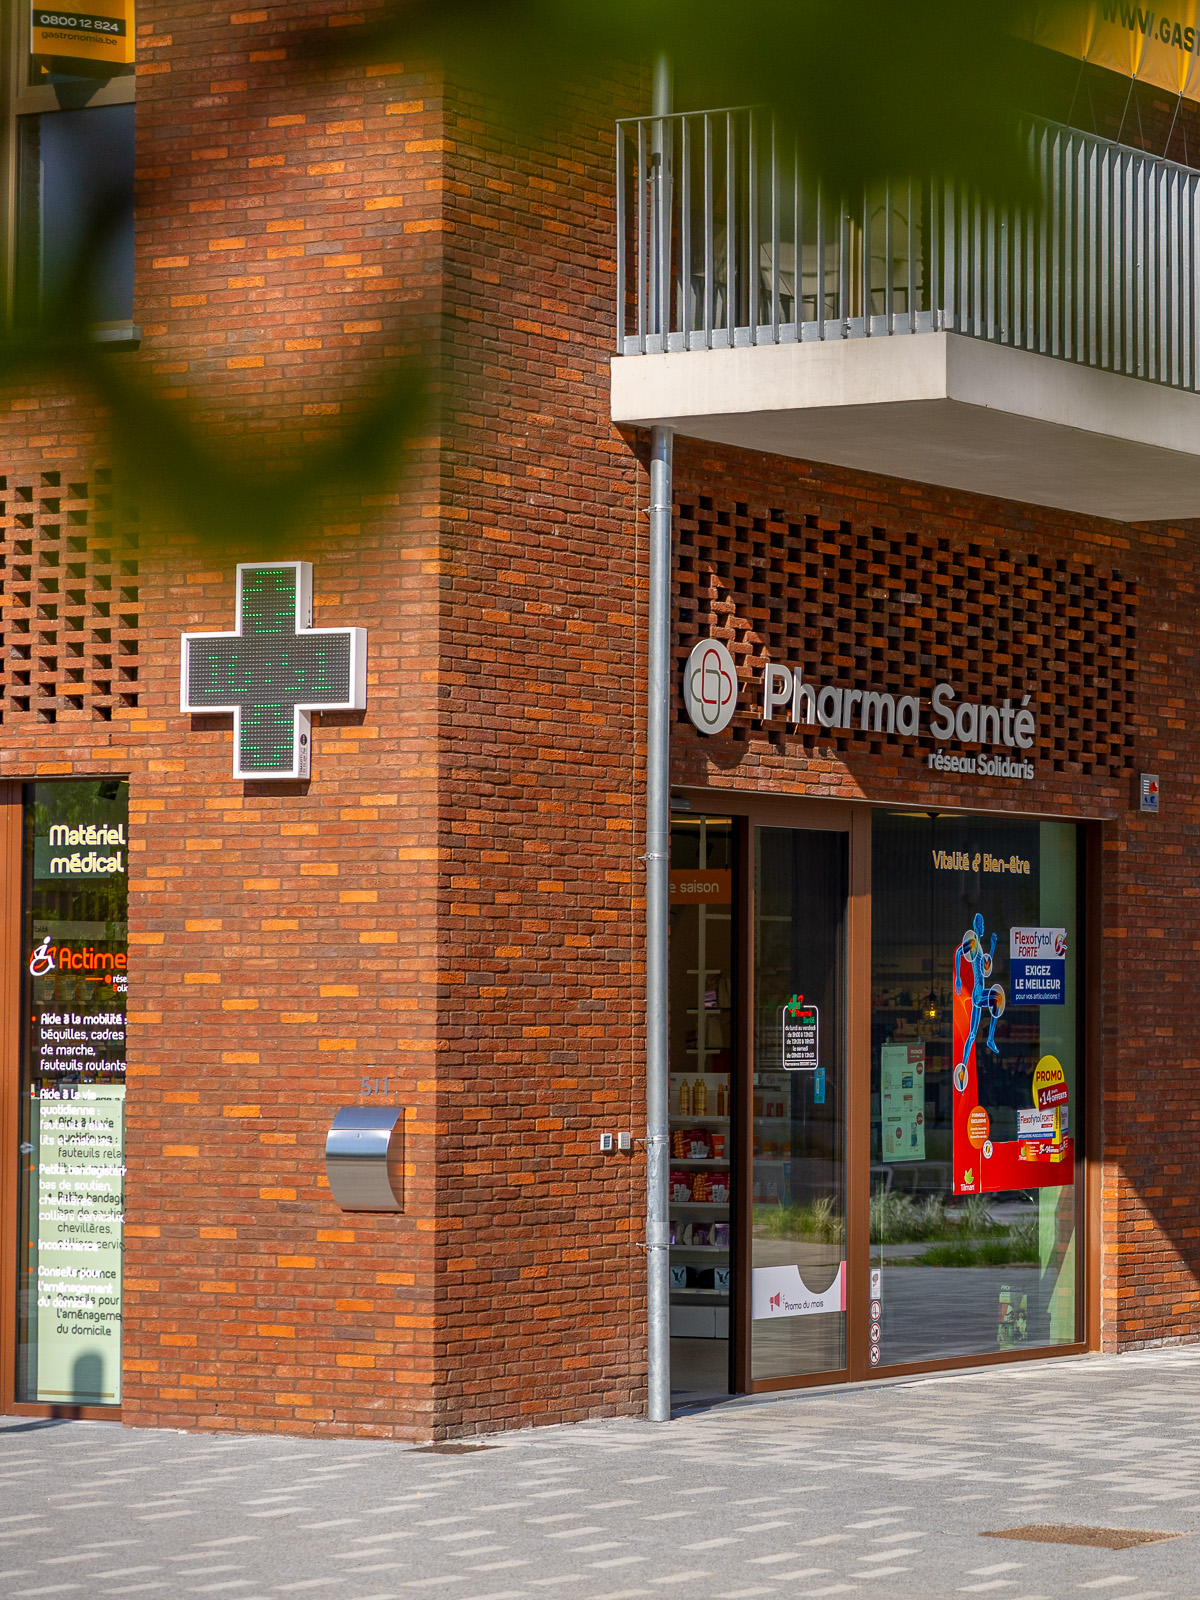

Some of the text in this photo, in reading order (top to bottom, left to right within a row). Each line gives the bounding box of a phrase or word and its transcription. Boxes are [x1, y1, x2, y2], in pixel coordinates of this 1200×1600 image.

[40, 15, 119, 32] 0800 12 824
[41, 31, 118, 45] gastronomia.be
[764, 662, 1036, 749] Pharma Santé
[928, 749, 1035, 780] réseau Solidaris
[49, 824, 126, 846] Matériel
[50, 851, 125, 874] médical
[932, 850, 970, 871] Vitalité
[983, 853, 1031, 874] Bien-être
[680, 880, 719, 893] saison
[1014, 931, 1052, 948] Flexofytol
[1018, 946, 1038, 957] FORTE
[58, 946, 129, 970] Actime
[1025, 965, 1051, 976] EXIGEZ
[1015, 979, 1061, 990] LE MEILLEUR
[40, 1013, 61, 1025] Aide
[63, 1013, 70, 1025] à
[71, 1013, 81, 1025] la
[83, 1013, 122, 1025] mobilité
[40, 1028, 125, 1042] béquilles, cadres
[40, 1044, 96, 1056] de marche,
[39, 1059, 83, 1071] fauteuils
[1036, 1070, 1062, 1082] PROMO
[40, 1088, 60, 1100] Aide
[62, 1088, 69, 1100] à
[70, 1088, 80, 1100] la
[40, 1104, 96, 1117] quotidienne
[40, 1134, 55, 1146] lits
[39, 1163, 66, 1175] Petite
[39, 1179, 112, 1191] bas de soutien,
[39, 1210, 75, 1221] colliers
[784, 1299, 824, 1310] Promo du mois
